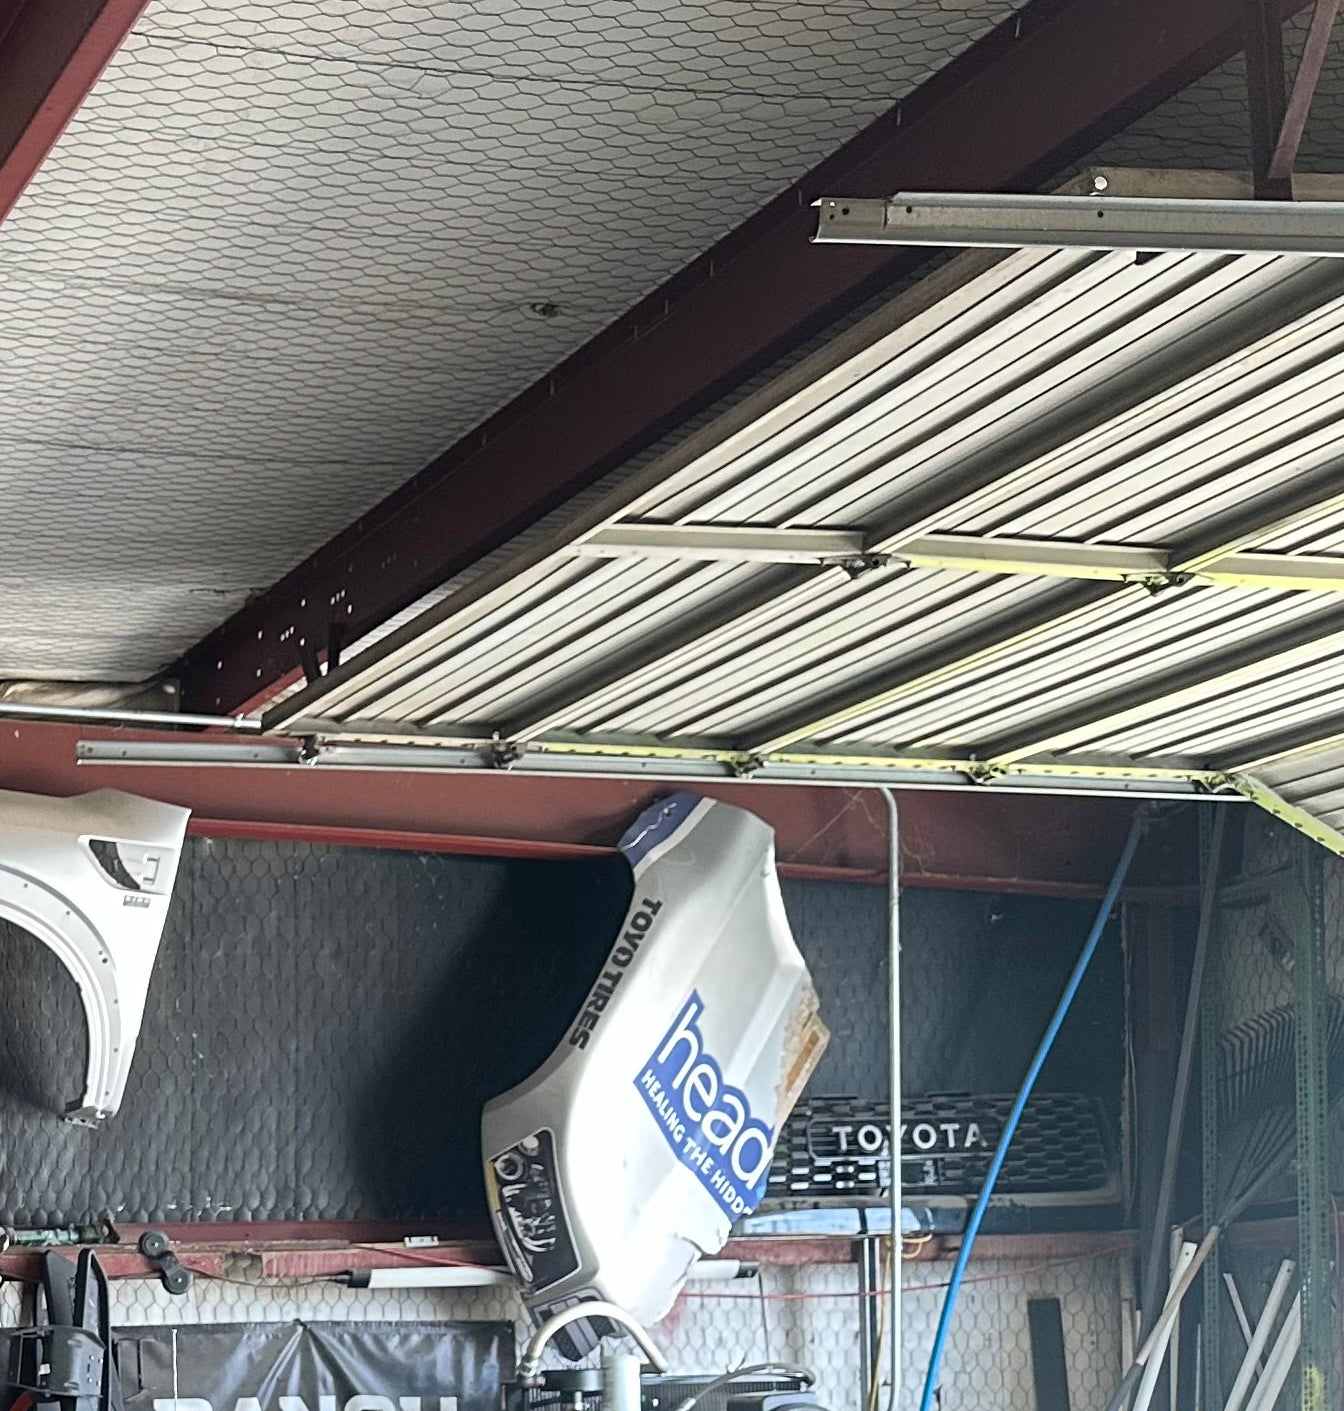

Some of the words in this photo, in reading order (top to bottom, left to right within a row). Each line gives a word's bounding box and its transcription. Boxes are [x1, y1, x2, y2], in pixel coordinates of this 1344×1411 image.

[611, 898, 663, 968] TOYO
[569, 971, 623, 1051] TIRES
[641, 1068, 686, 1143] HEALING
[682, 1136, 714, 1175] THE
